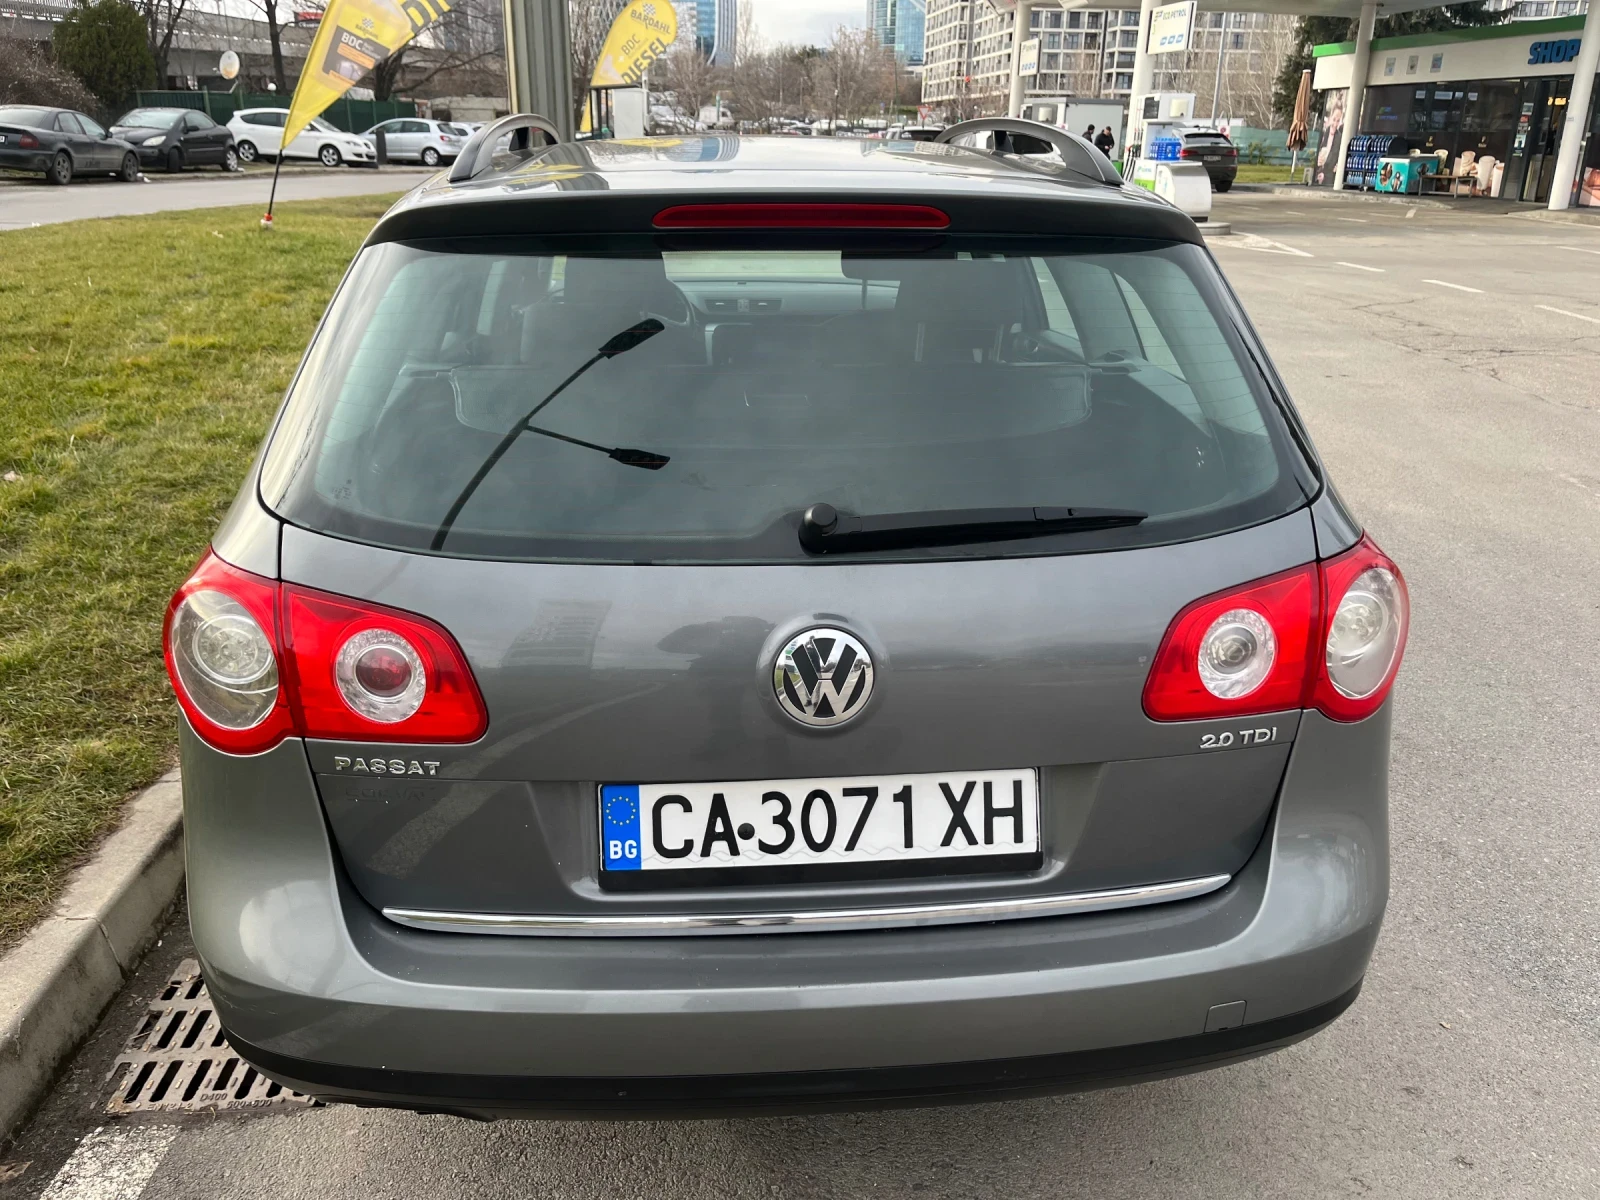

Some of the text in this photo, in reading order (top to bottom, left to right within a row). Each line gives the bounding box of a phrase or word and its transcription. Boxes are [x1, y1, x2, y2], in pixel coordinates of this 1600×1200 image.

[630, 9, 672, 35] BARDAHL
[341, 31, 364, 50] BDC
[621, 34, 641, 56] BDC
[621, 37, 669, 84] DIESEL
[1528, 38, 1582, 65] SHOP
[1239, 726, 1277, 745] TDI
[334, 756, 440, 775] PASSAT
[608, 839, 638, 860] BG
[200, 1092, 228, 1101] D400
